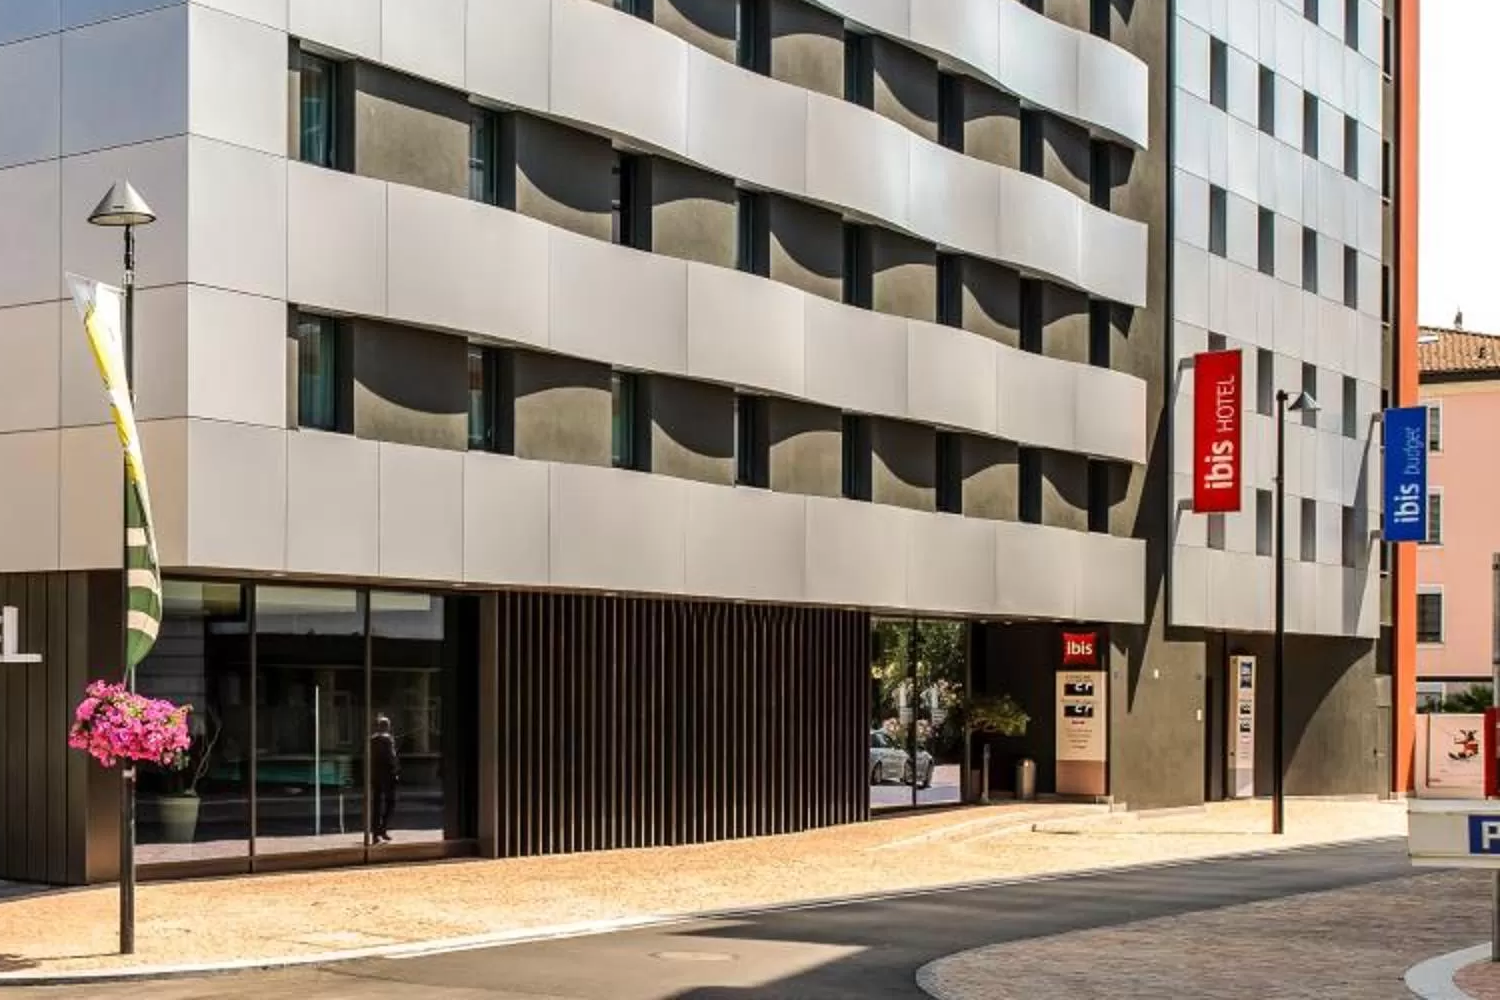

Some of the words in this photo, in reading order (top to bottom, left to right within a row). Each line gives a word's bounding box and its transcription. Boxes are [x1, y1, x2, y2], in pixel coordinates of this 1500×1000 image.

[1215, 373, 1235, 433] HOTEL
[1204, 439, 1234, 489] ibis
[1403, 427, 1424, 475] budget
[1393, 483, 1420, 523] ibis
[1067, 640, 1093, 655] ibis
[1482, 821, 1500, 849] P
